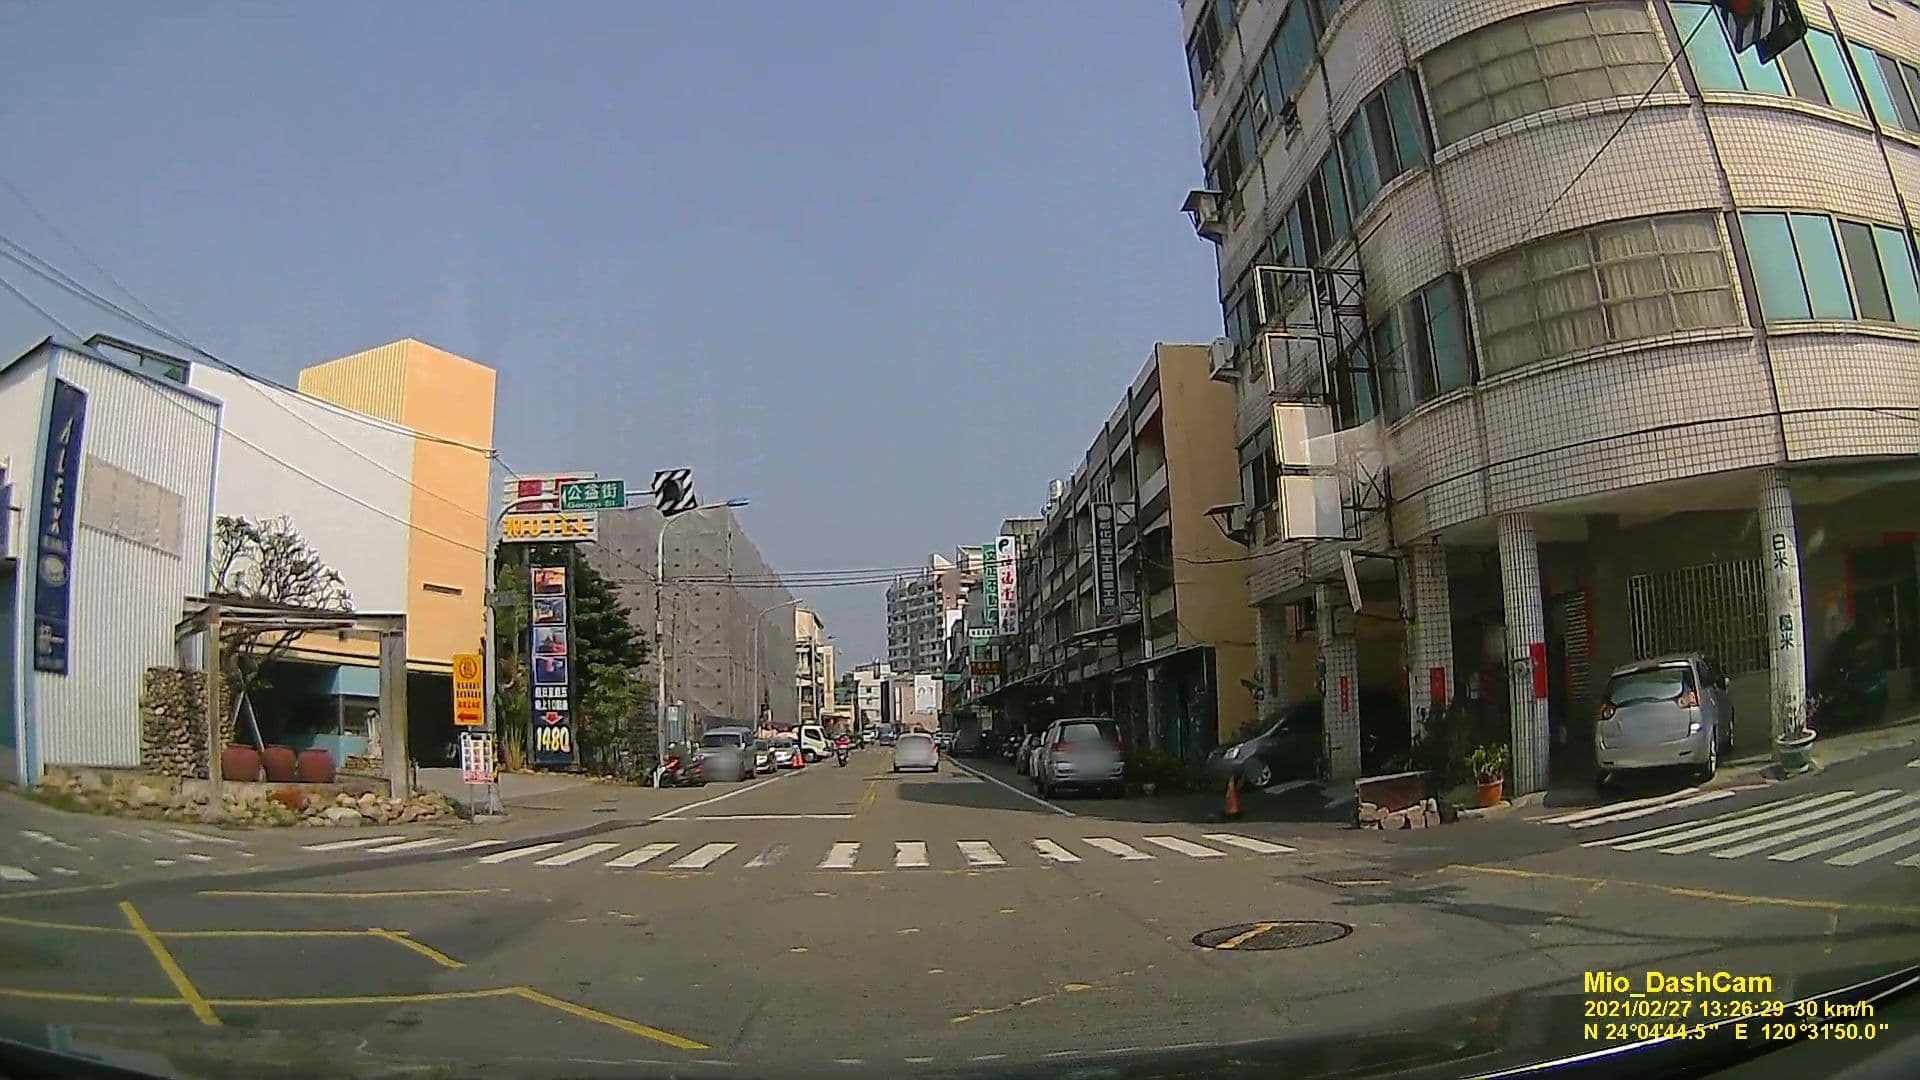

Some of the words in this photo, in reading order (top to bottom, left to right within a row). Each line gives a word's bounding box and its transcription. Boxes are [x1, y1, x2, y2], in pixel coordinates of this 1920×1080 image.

[49, 416, 74, 535] ALEX
[567, 483, 617, 500] 公益街
[536, 726, 571, 753] 1480
